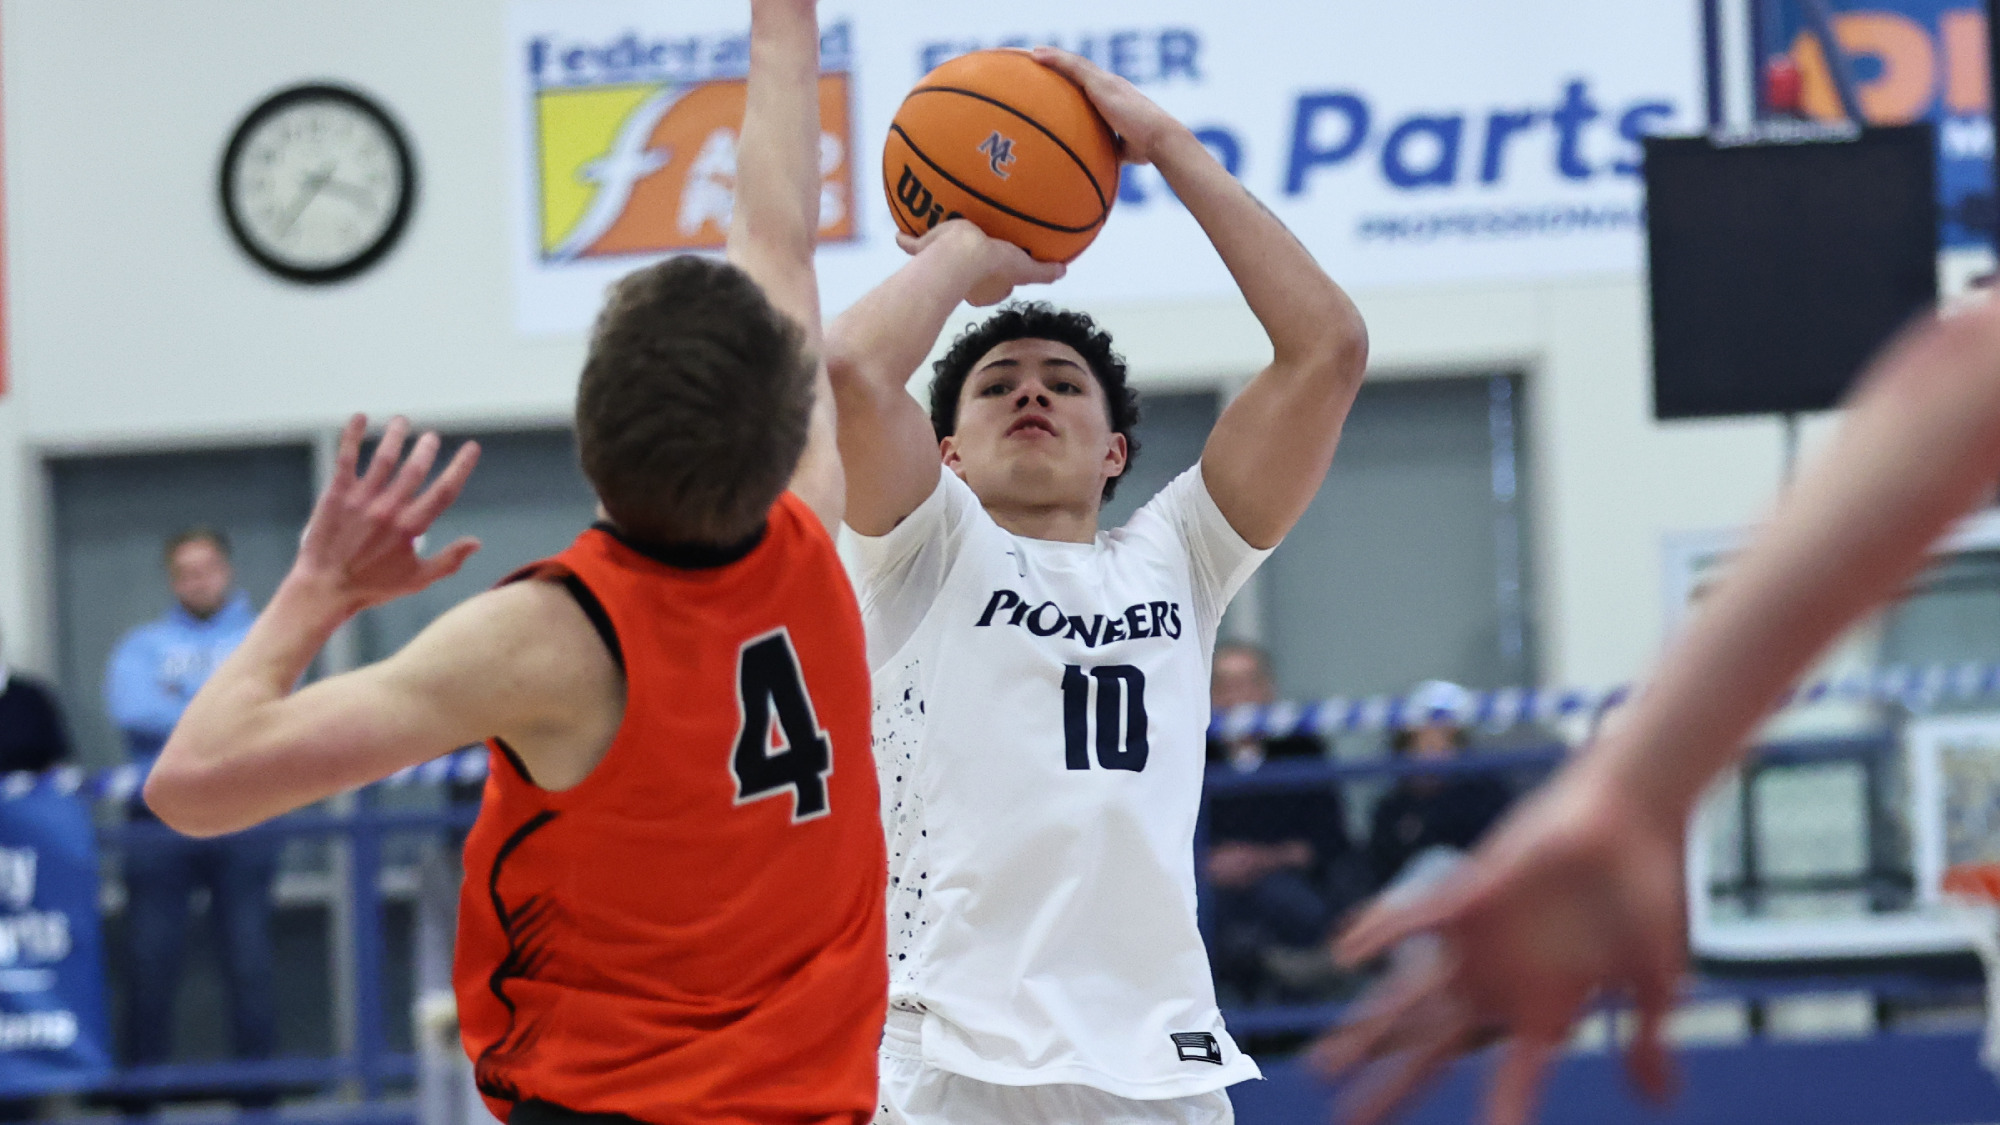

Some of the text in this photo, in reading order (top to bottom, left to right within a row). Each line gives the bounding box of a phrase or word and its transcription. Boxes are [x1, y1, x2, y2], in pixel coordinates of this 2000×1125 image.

[1283, 78, 1676, 196] Parts
[974, 589, 1181, 648] PIONEERS
[730, 626, 833, 824] 4
[1061, 663, 1149, 772] 10
